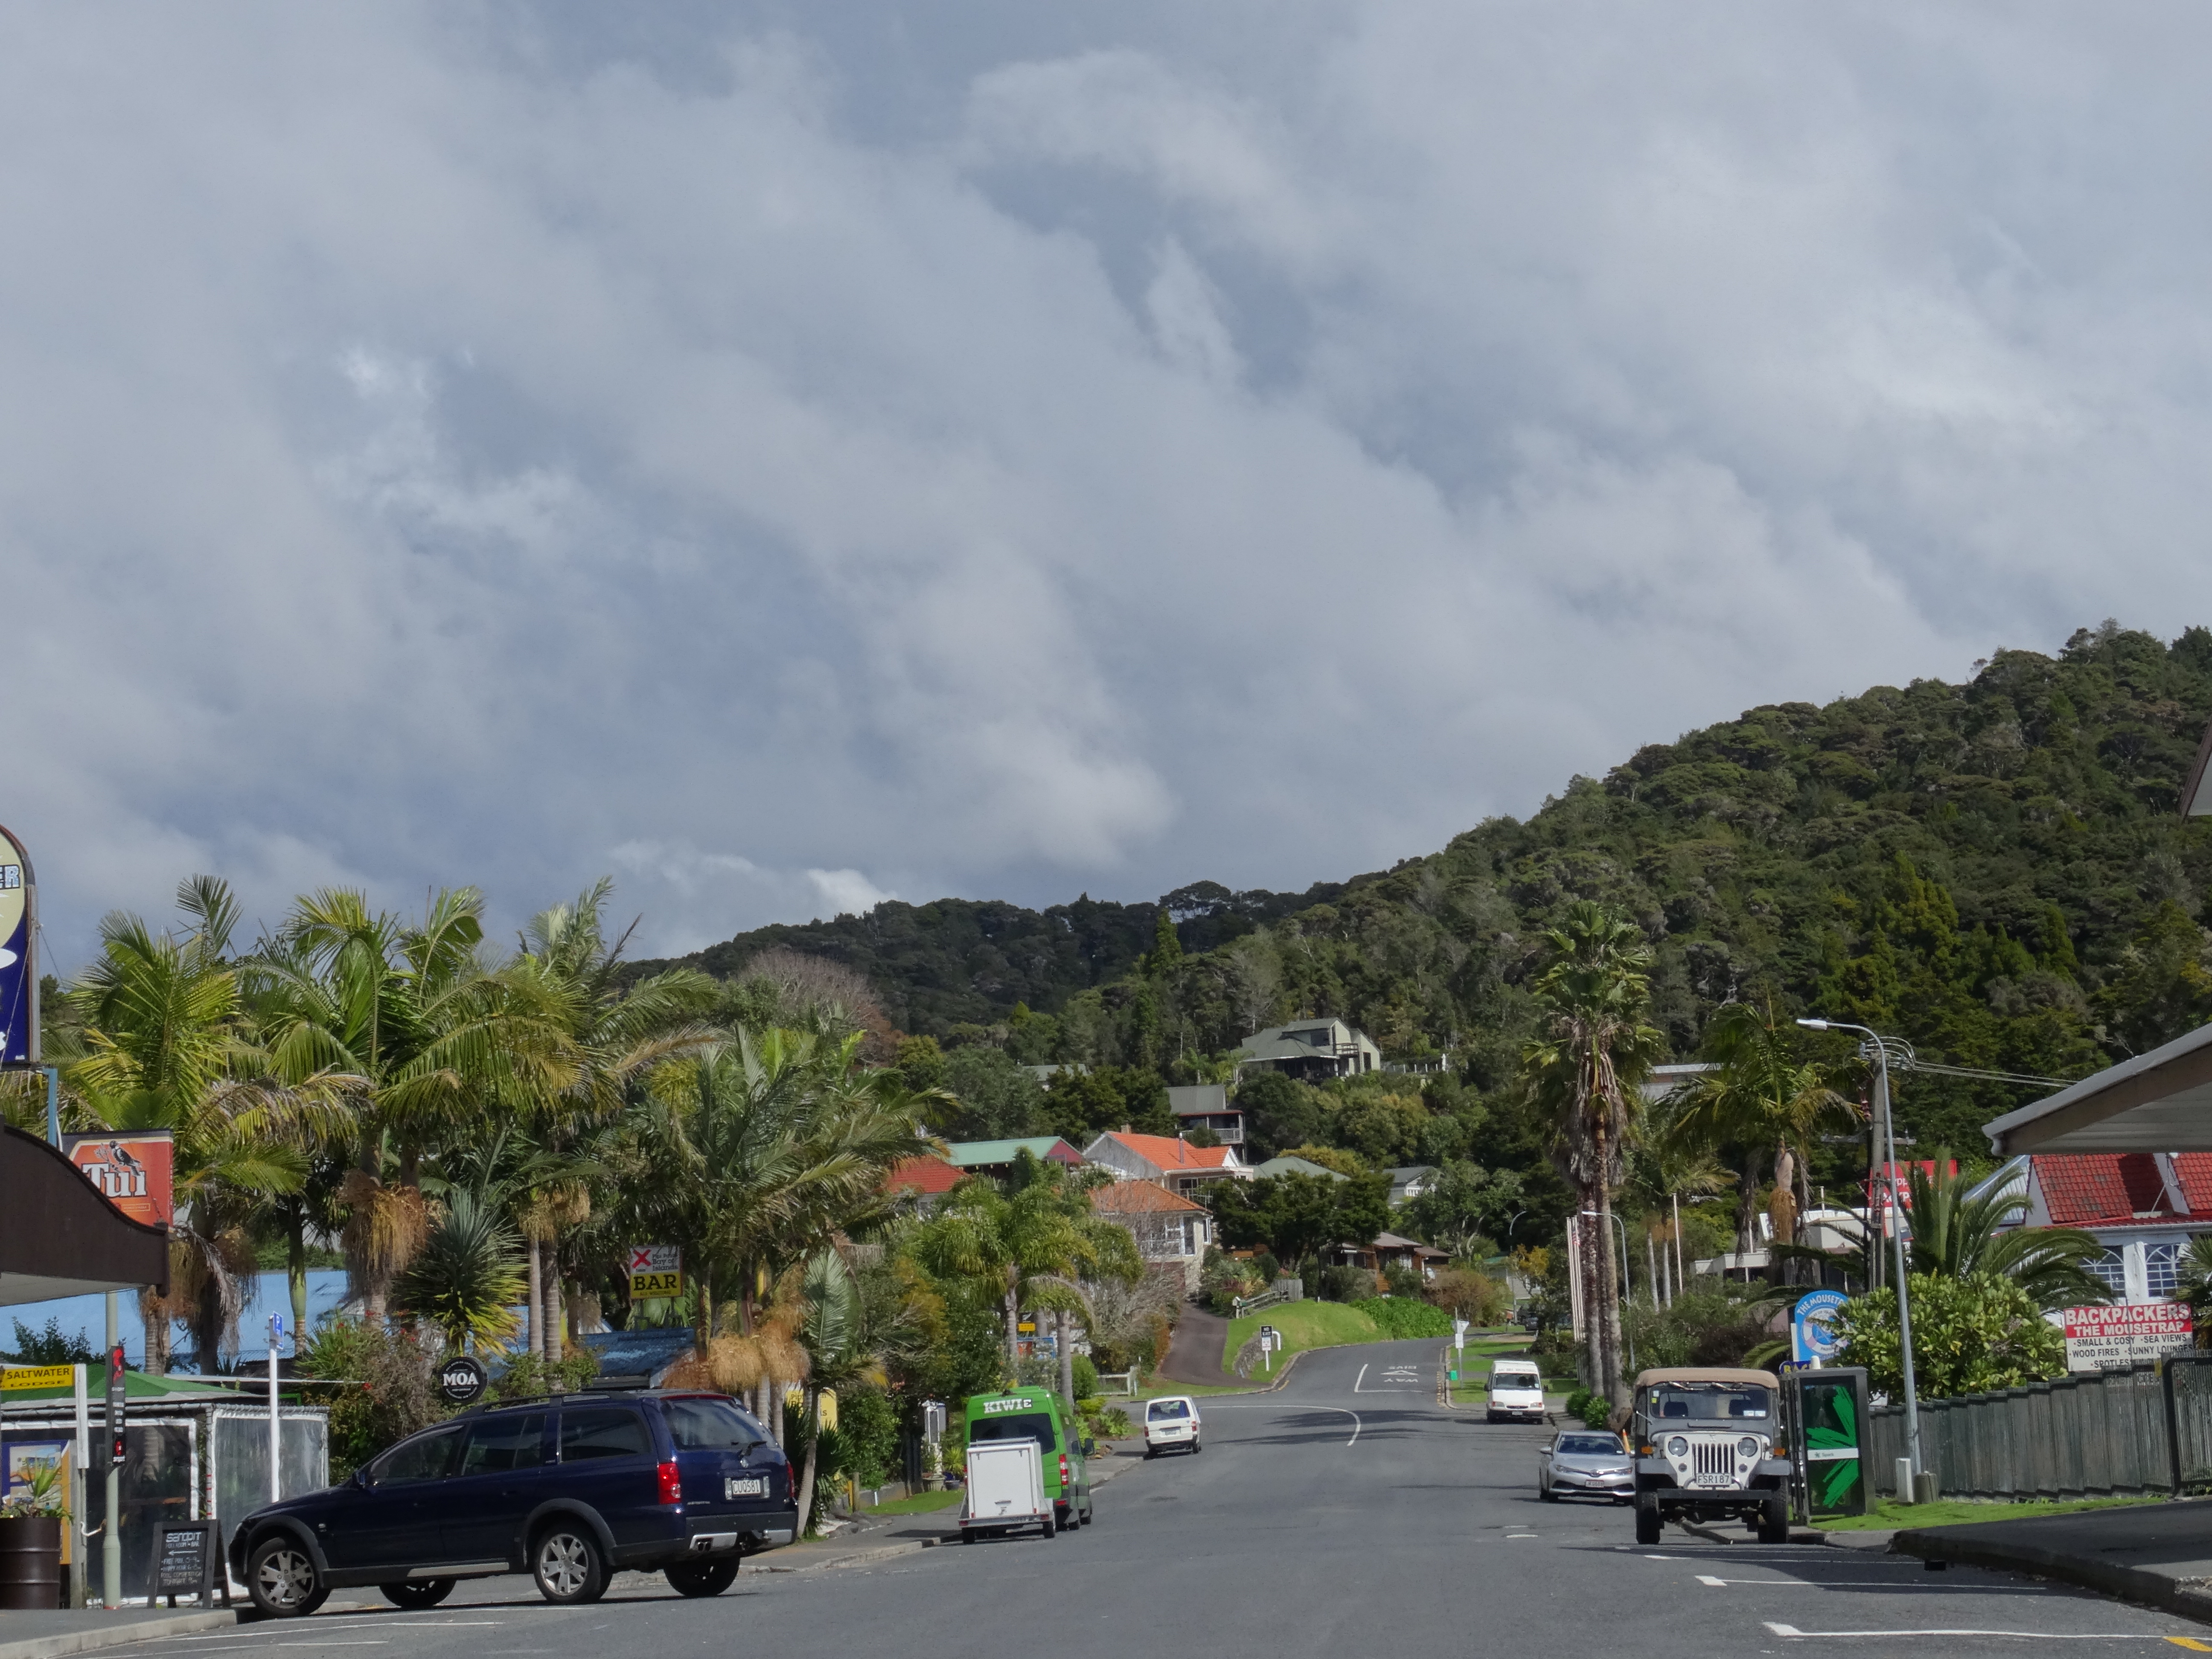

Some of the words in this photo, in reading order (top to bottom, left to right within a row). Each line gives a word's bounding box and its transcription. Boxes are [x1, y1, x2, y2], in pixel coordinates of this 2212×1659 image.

[81, 1163, 147, 1198] Tui
[634, 1274, 677, 1291] BAR
[1797, 1301, 1810, 1315] THE
[1810, 1294, 1845, 1306] MOUSETR
[2065, 1304, 2190, 1325] BACKPACKERS
[2073, 1325, 2101, 1337] THE
[2104, 1321, 2185, 1336] MOUSETRAP
[2077, 1338, 2103, 1347] SMALL
[2106, 1337, 2112, 1345] &
[2114, 1336, 2135, 1345] COSY
[2144, 1335, 2160, 1344] SEA
[2161, 1333, 2186, 1342] VIEWS
[2072, 1349, 2096, 1358] WOOD
[2098, 1348, 2119, 1356] FIRES
[2128, 1346, 2154, 1355] SUNNY
[2094, 1359, 2131, 1368] SPOTLES
[7, 1368, 70, 1379] SALTWATER
[443, 1372, 479, 1386] MOA
[1698, 1475, 1729, 1483] FSR187
[733, 1480, 760, 1493] CUQ581
